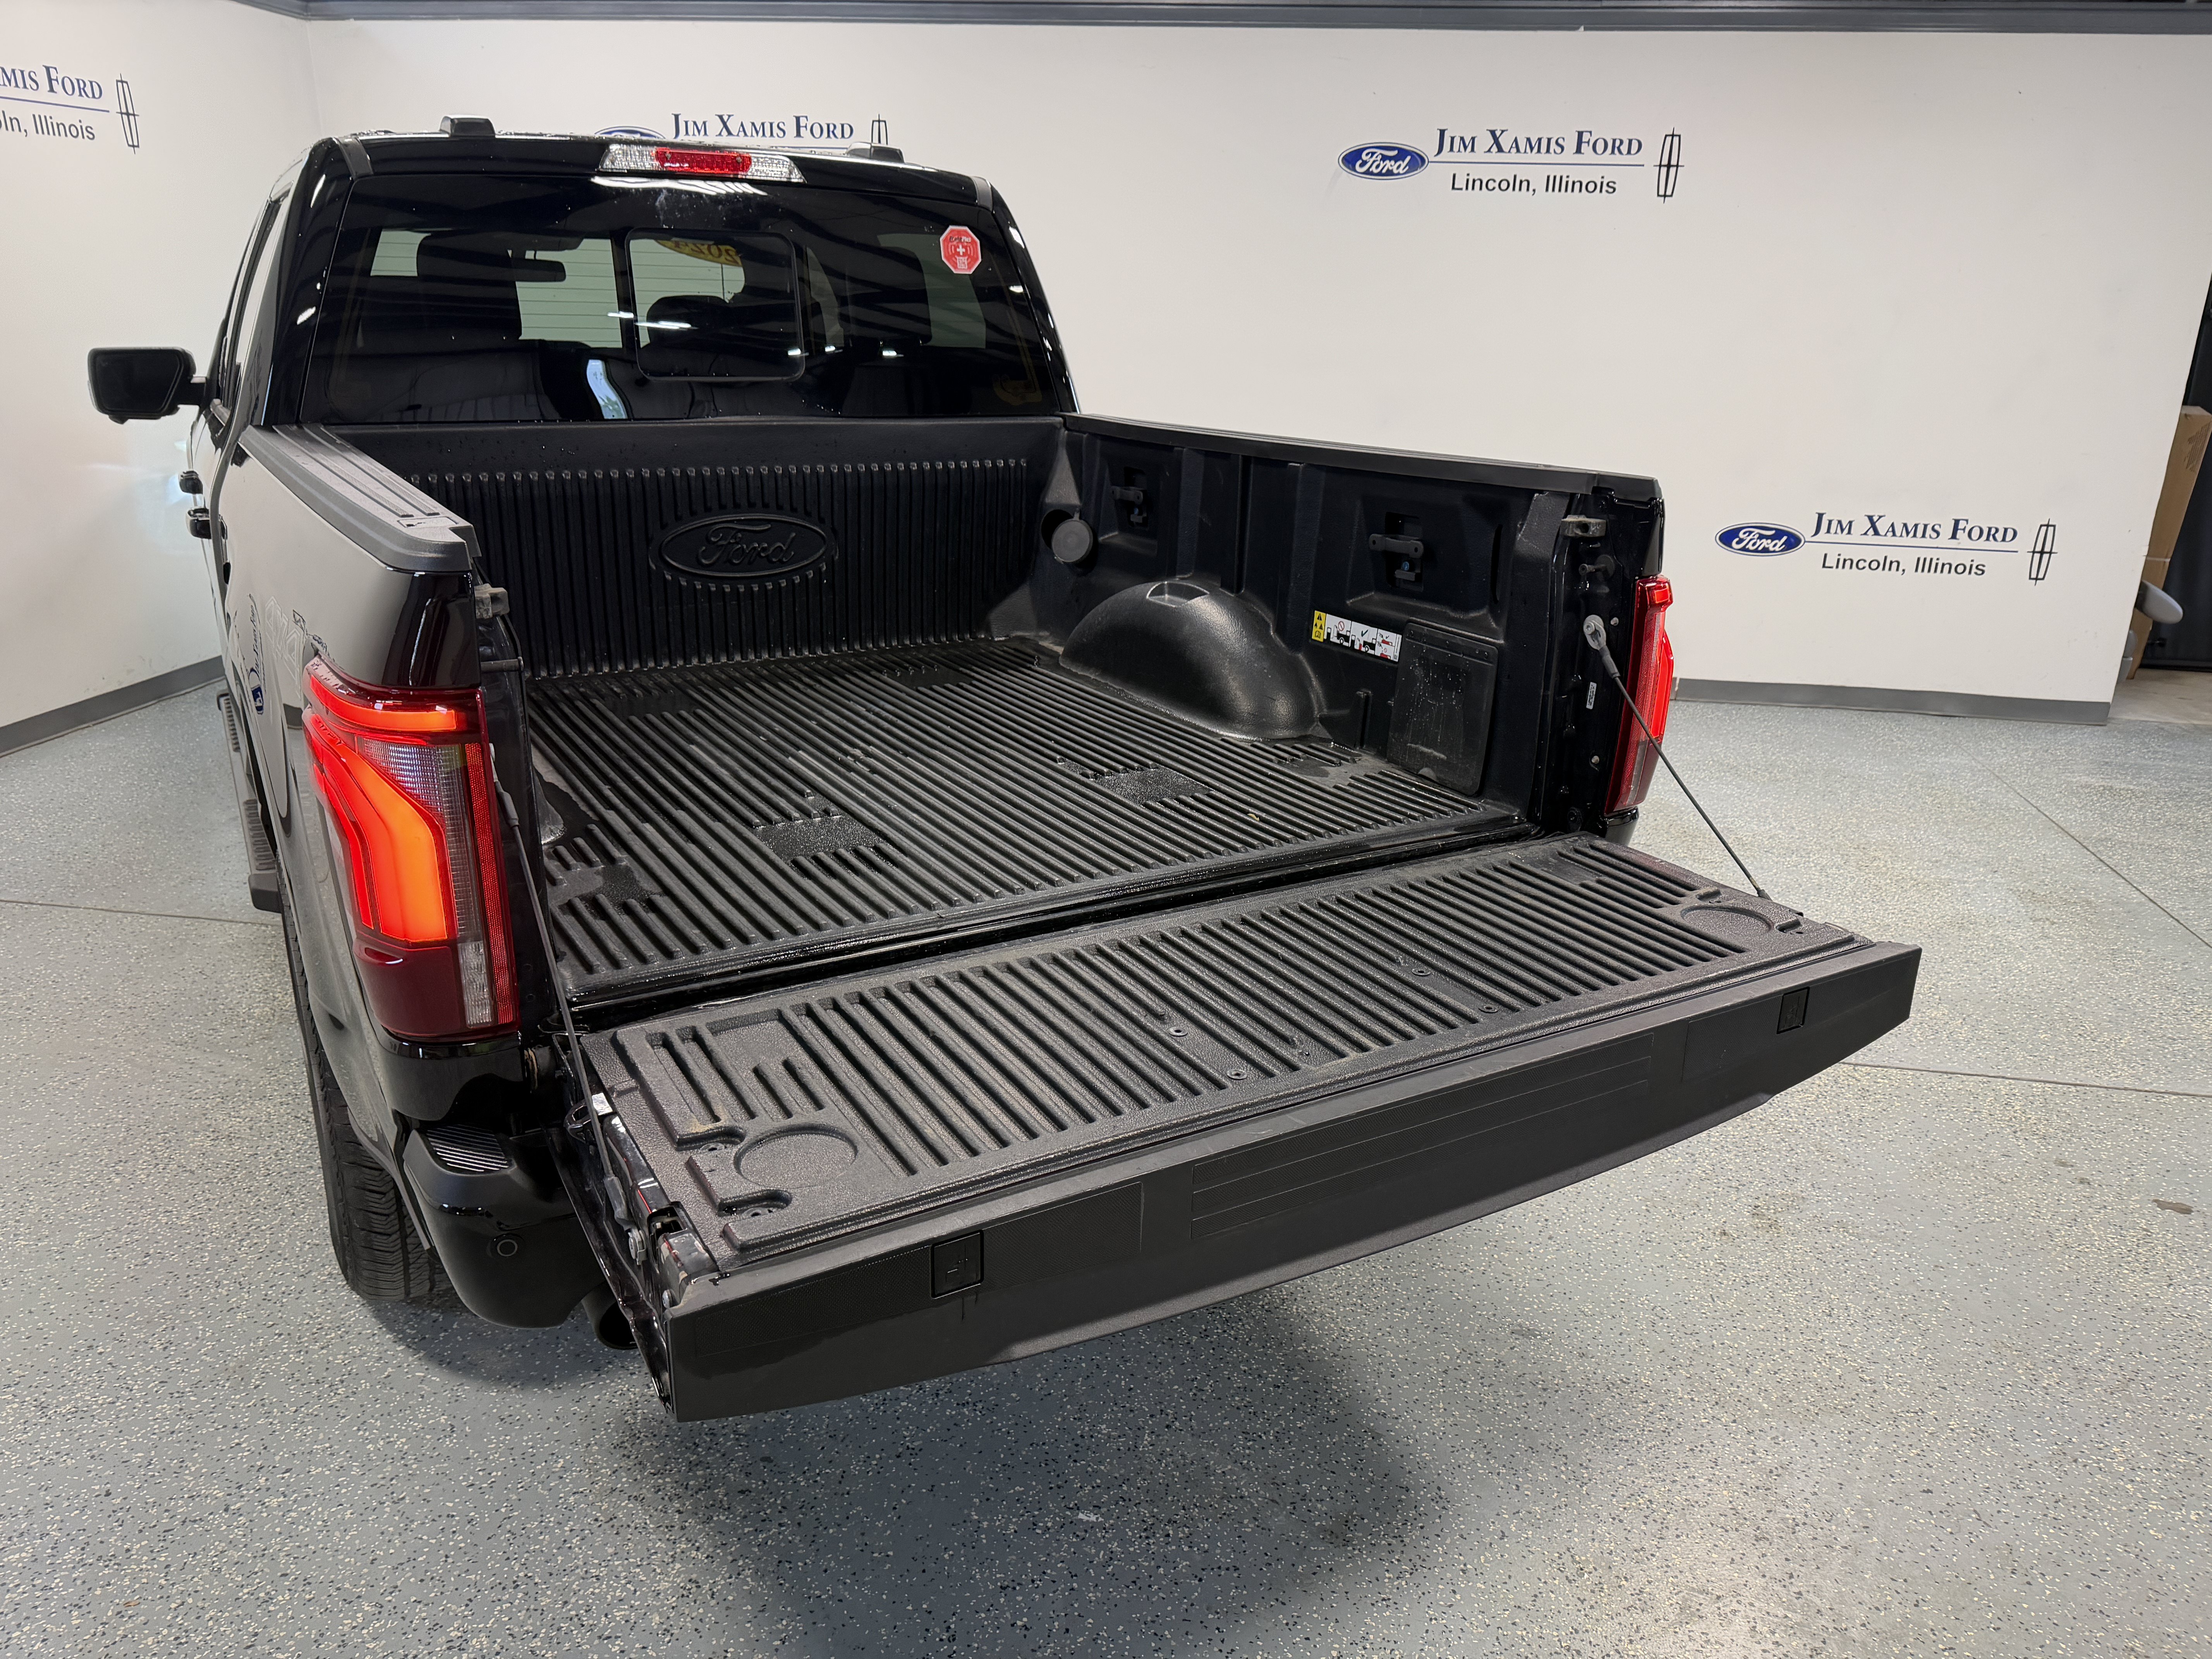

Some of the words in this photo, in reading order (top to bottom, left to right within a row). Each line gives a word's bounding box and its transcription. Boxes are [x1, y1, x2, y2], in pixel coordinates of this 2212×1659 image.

[0, 66, 39, 91] MIS
[42, 65, 103, 100] FORD
[32, 114, 95, 141] Illinois
[672, 113, 708, 139] JIM
[715, 114, 786, 138] XAMIS
[793, 115, 854, 139] FORD
[1434, 129, 1476, 157] JIM
[1484, 129, 1565, 155] XAMIS
[1573, 130, 1642, 155] FORD
[1355, 148, 1409, 174] Ford
[1451, 173, 1536, 196] Lincoln,
[1545, 175, 1616, 194] Illinois
[1731, 527, 1786, 551] Ford
[1811, 512, 1854, 538] JIM
[1860, 515, 1941, 539] XAMIS
[1948, 518, 2018, 543] FORD
[699, 523, 796, 565] Ford
[1822, 553, 1905, 575] Lincoln,
[1915, 557, 1985, 576] Illinois
